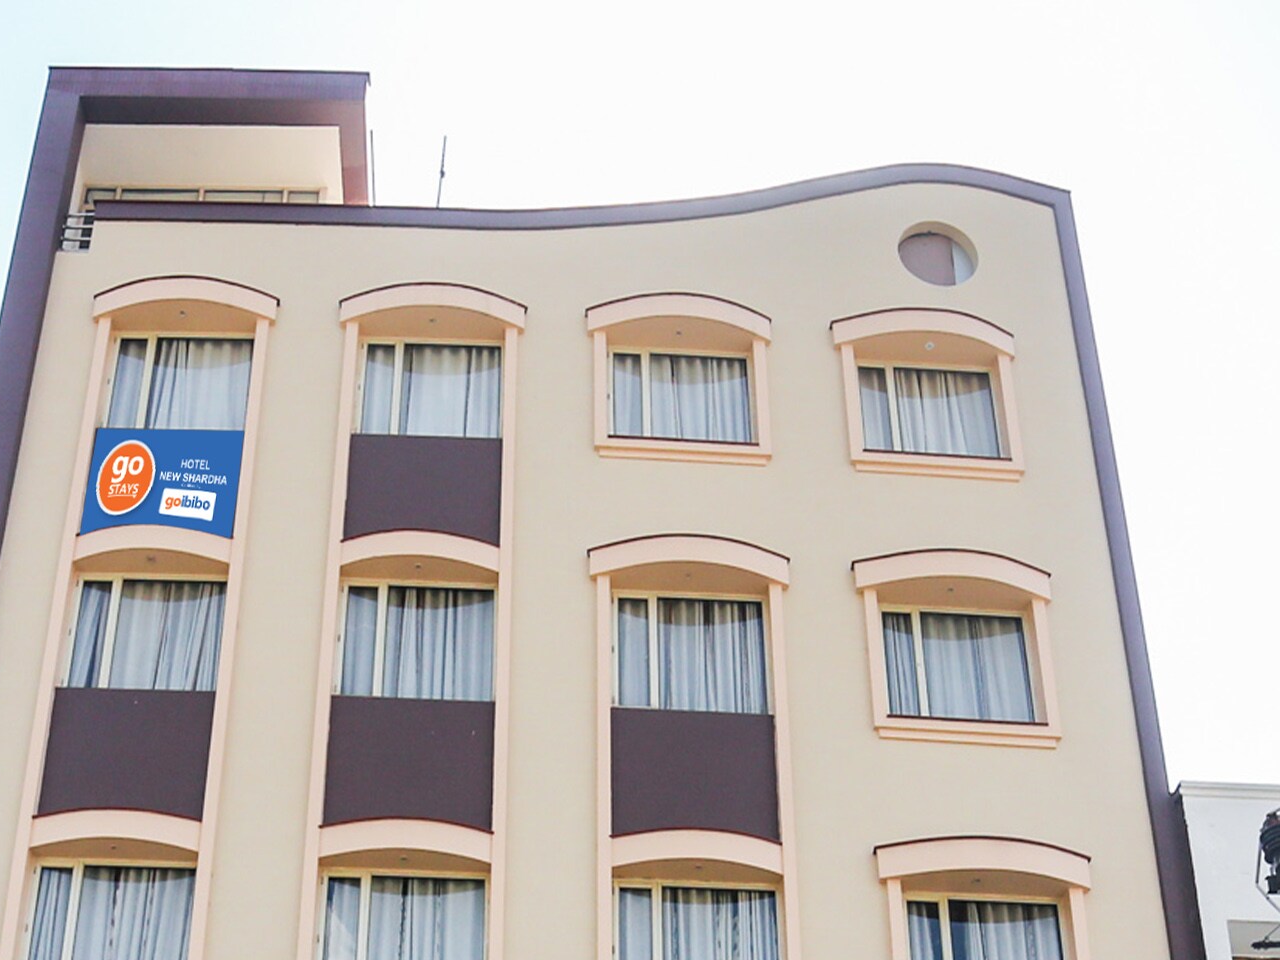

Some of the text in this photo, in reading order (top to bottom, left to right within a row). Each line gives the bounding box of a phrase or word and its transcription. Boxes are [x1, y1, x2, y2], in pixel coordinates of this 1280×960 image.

[111, 455, 144, 483] go
[181, 459, 210, 470] HOTEL
[159, 471, 182, 482] NEW
[182, 472, 227, 486] SHARDHA
[108, 483, 140, 495] STAYS
[165, 495, 211, 510] goibibo
